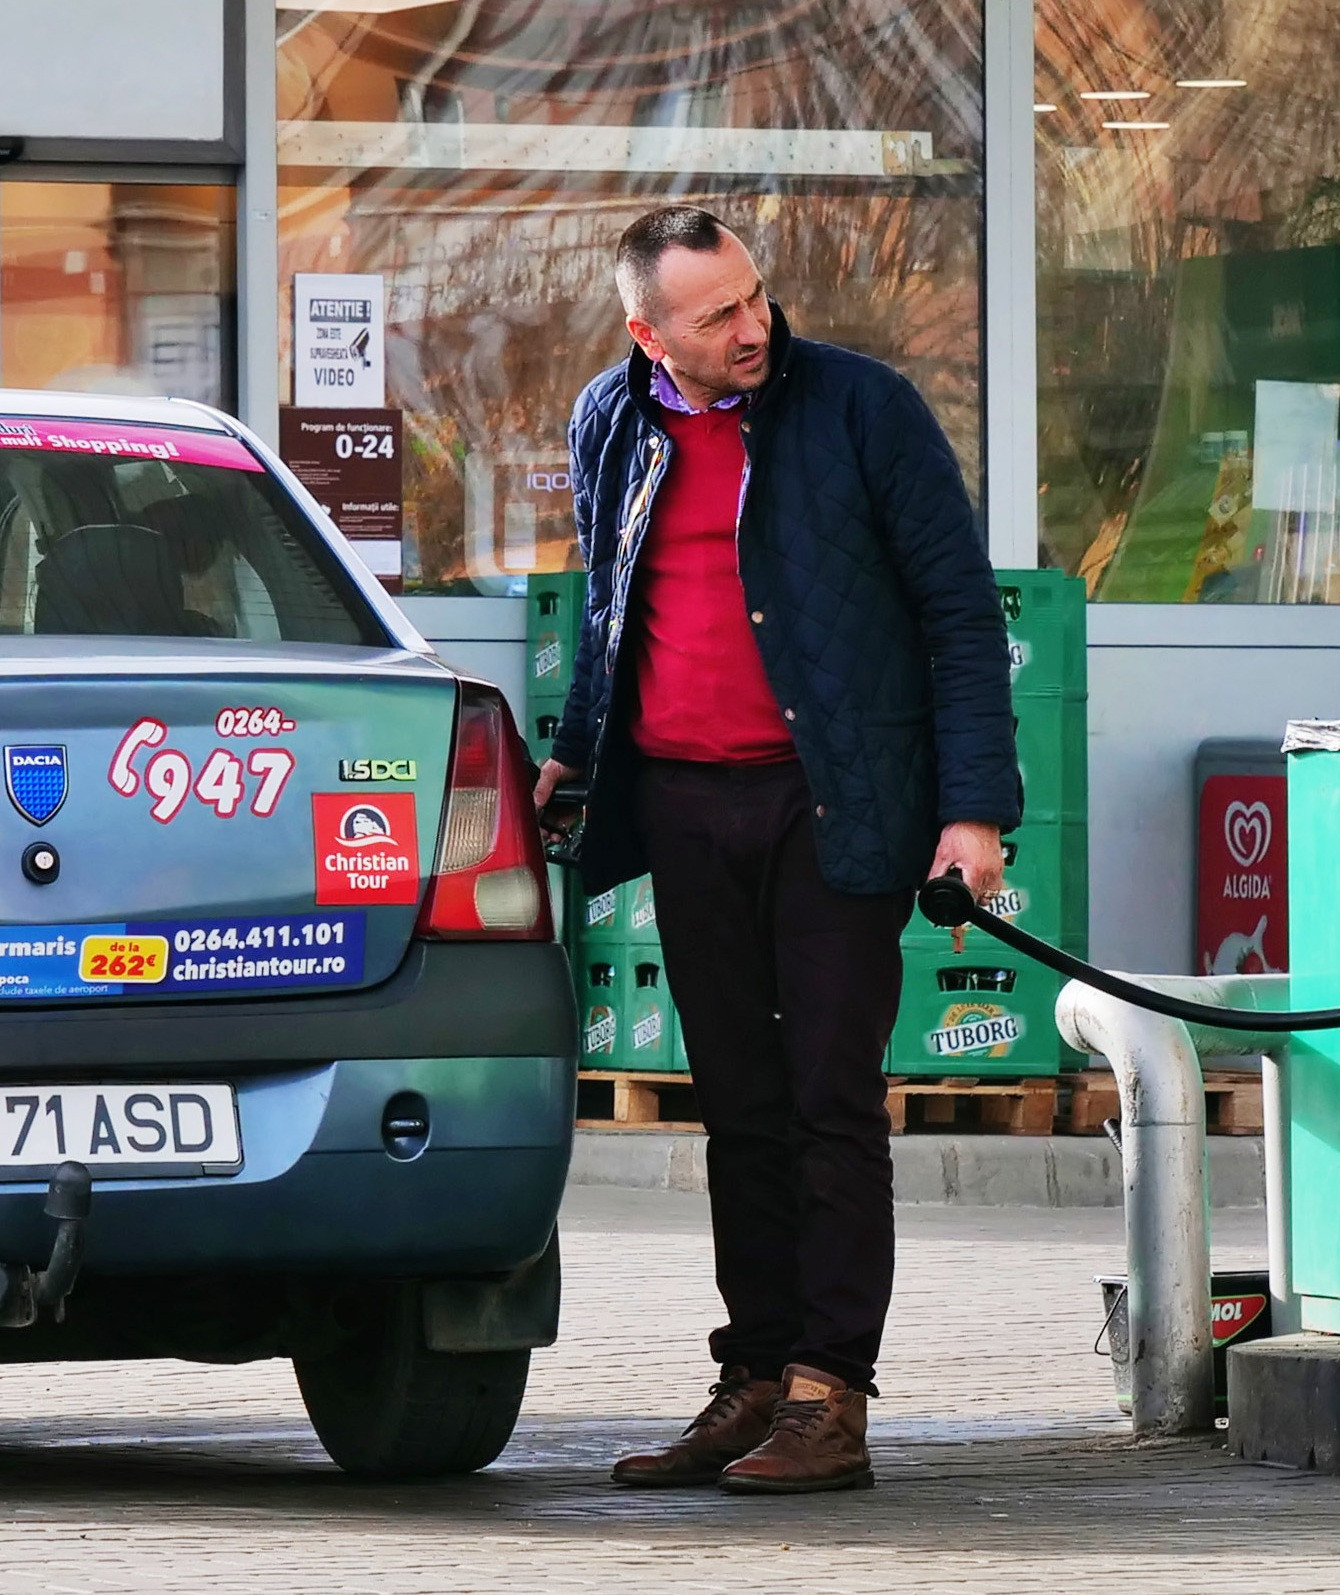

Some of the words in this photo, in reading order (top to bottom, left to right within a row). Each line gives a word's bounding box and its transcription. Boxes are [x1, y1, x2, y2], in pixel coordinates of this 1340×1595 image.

[314, 367, 355, 387] VIDEO
[301, 422, 334, 434] Program
[335, 423, 345, 432] de
[0, 433, 43, 447] mult
[47, 434, 181, 460] Shopping!
[335, 434, 395, 459] 0-24
[526, 472, 570, 492] IQO
[381, 503, 400, 512] utile:
[215, 706, 297, 738] 0264-
[12, 754, 62, 766] DACIA
[146, 748, 296, 824] 947
[324, 851, 409, 872] Christian
[346, 873, 390, 890] Tour
[1222, 874, 1271, 900] ALGIDA
[0, 935, 77, 958] rmaris
[110, 942, 125, 953] de
[128, 942, 140, 953] la
[173, 921, 344, 953] 0264.411.101
[90, 954, 157, 977] 262€
[172, 954, 346, 982] christiantour.ro
[0, 975, 30, 987] poca
[25, 985, 53, 996] taxele
[54, 985, 67, 995] de
[68, 984, 109, 995] aeroport
[930, 1017, 1019, 1053] TUBORG
[5, 1094, 67, 1157] 71
[89, 1092, 215, 1156] ASD
[1210, 1301, 1243, 1322] MOL
